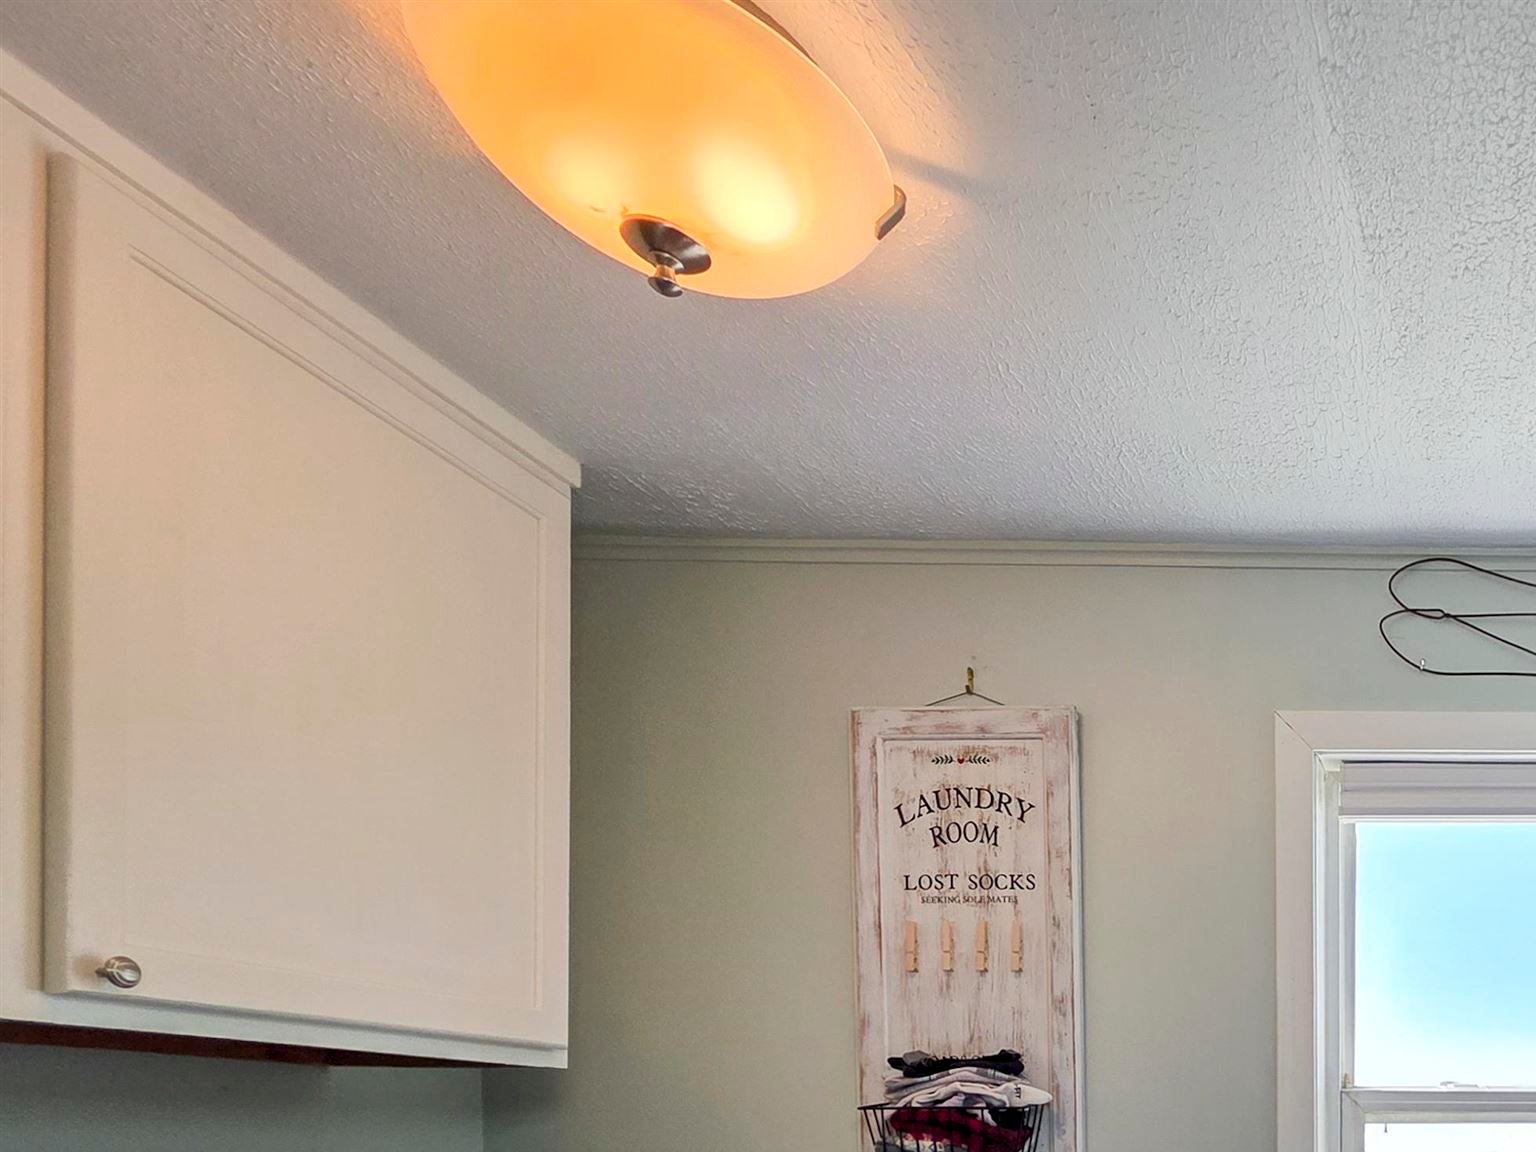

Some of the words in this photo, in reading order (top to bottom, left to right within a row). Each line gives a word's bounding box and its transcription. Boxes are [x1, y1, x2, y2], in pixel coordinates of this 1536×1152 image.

[893, 786, 1036, 829] LAUNDRY
[928, 820, 1000, 849] ROOM
[903, 873, 959, 892] LOST
[968, 873, 1037, 892] SOCKS
[920, 895, 961, 905] SEEKING
